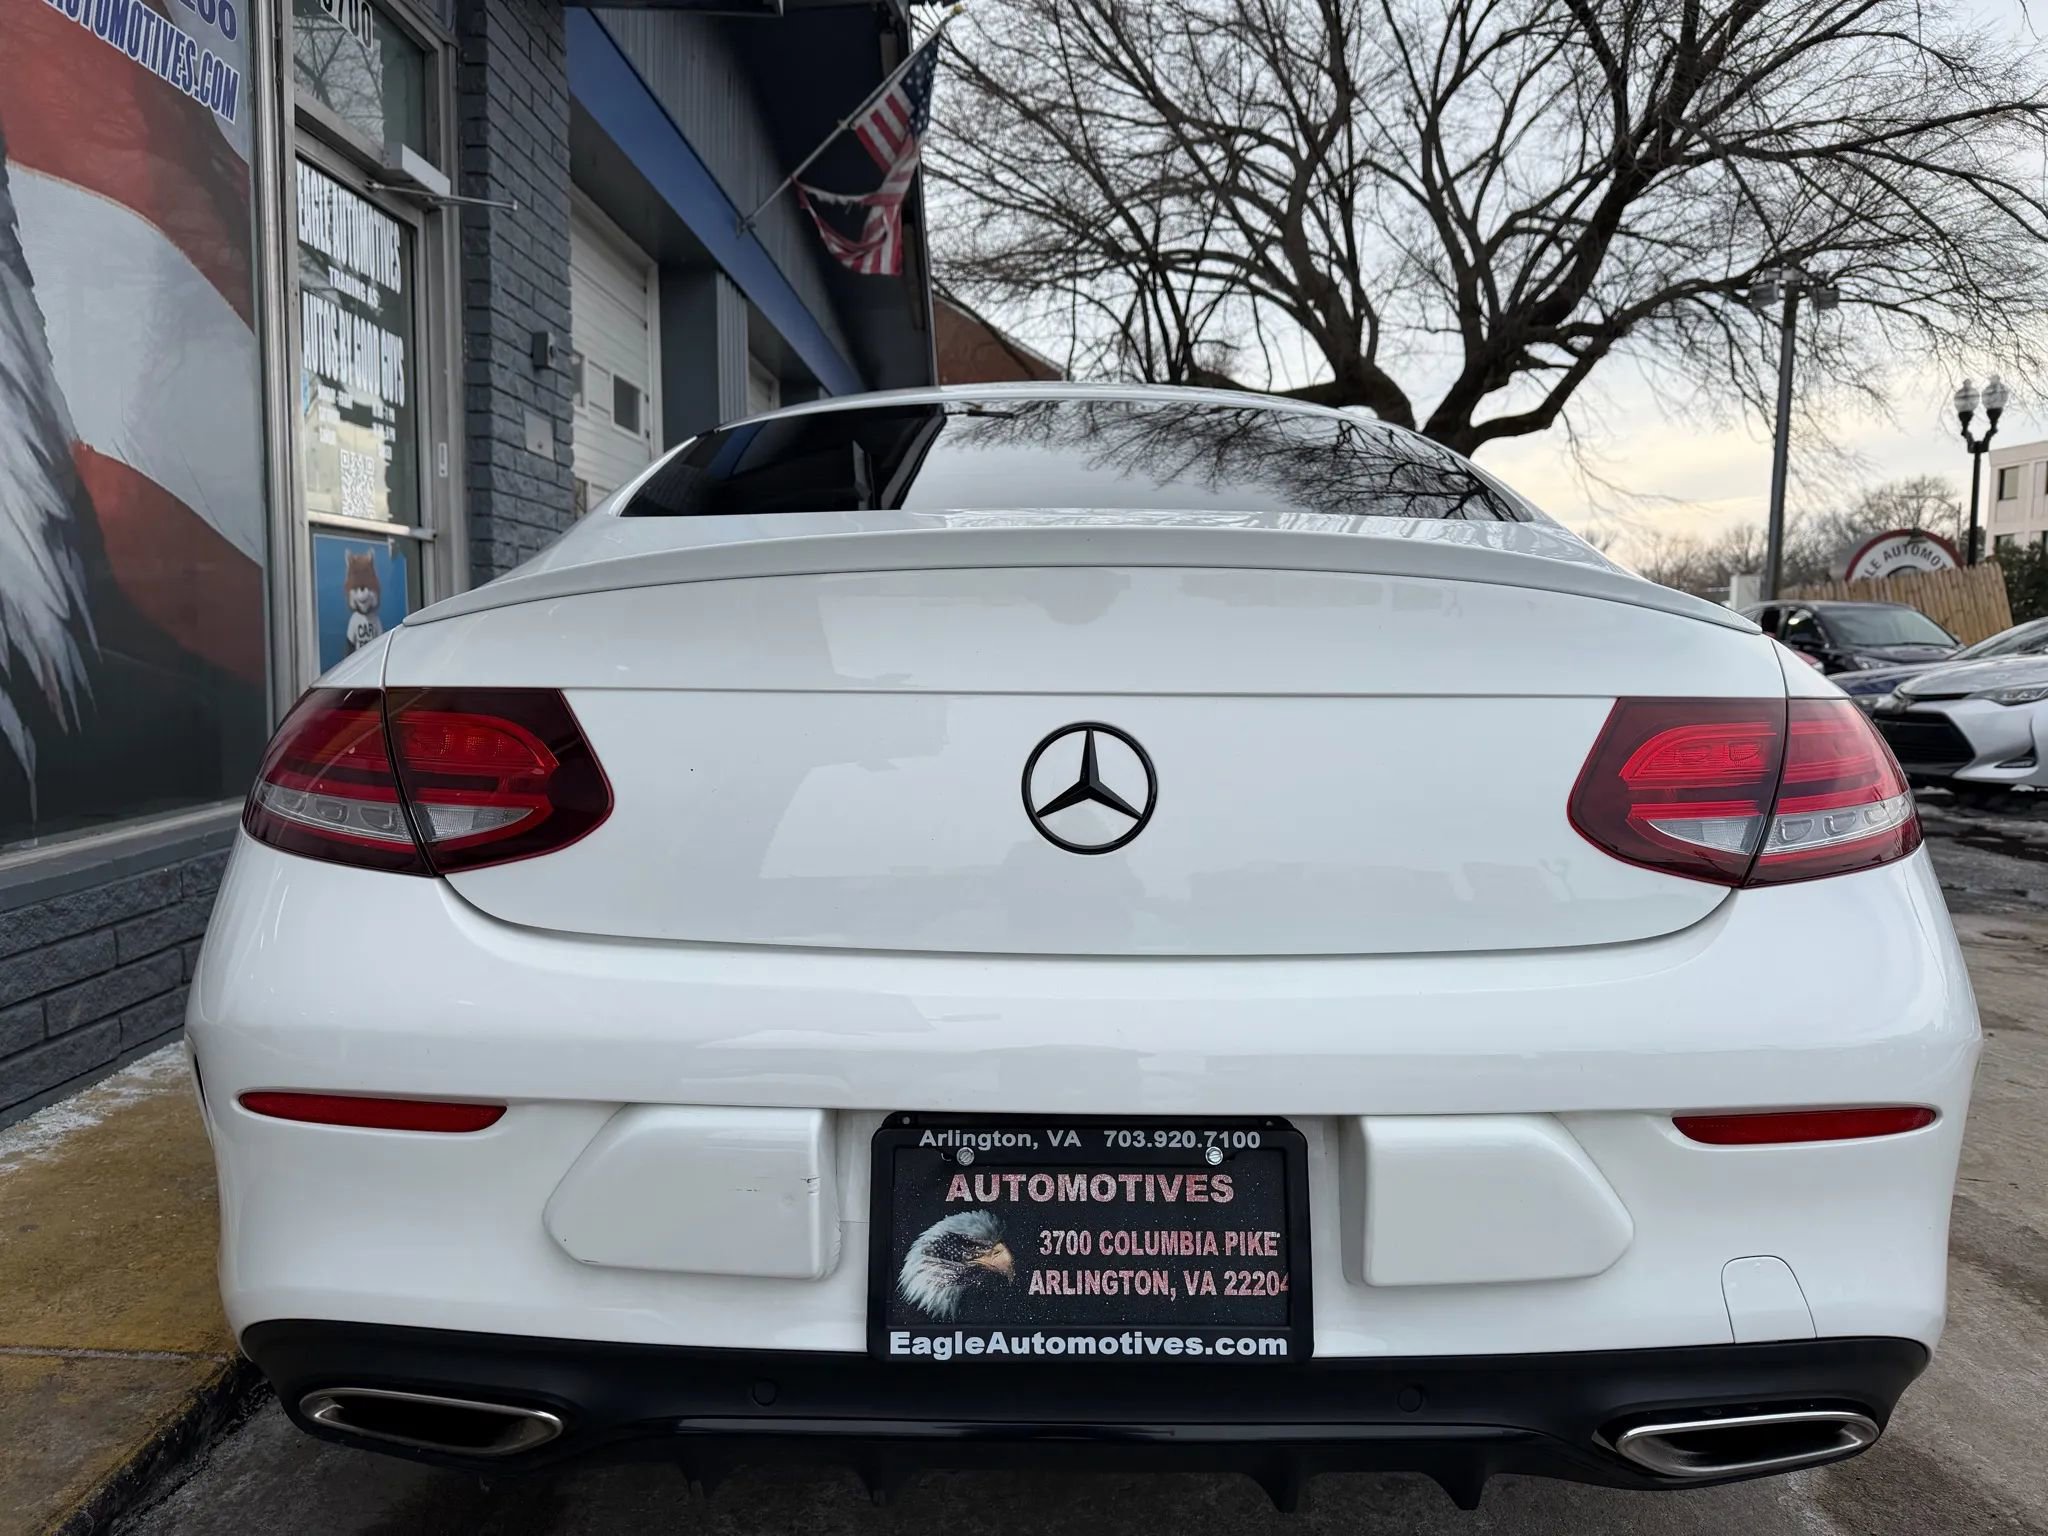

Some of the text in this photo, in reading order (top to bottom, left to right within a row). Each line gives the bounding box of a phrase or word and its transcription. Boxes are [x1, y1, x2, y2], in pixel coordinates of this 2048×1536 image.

[44, 0, 240, 124] OMOTIVES.COM
[296, 158, 401, 295] EAGLE AUTOMOTIVES
[328, 265, 366, 304] TRADING
[303, 290, 405, 408] AUTOS BY GOOD GUYS
[919, 1129, 1261, 1151] Arlington, VA 703.920.7100
[945, 1173, 1235, 1203] AUTOMOTIVES
[1039, 1229, 1279, 1257] 3700 COLUMBIA PIKE
[1028, 1269, 1177, 1301] ARLINGTON,
[1184, 1270, 1217, 1297] VA
[889, 1330, 1288, 1360] EagleAutomotives.com
